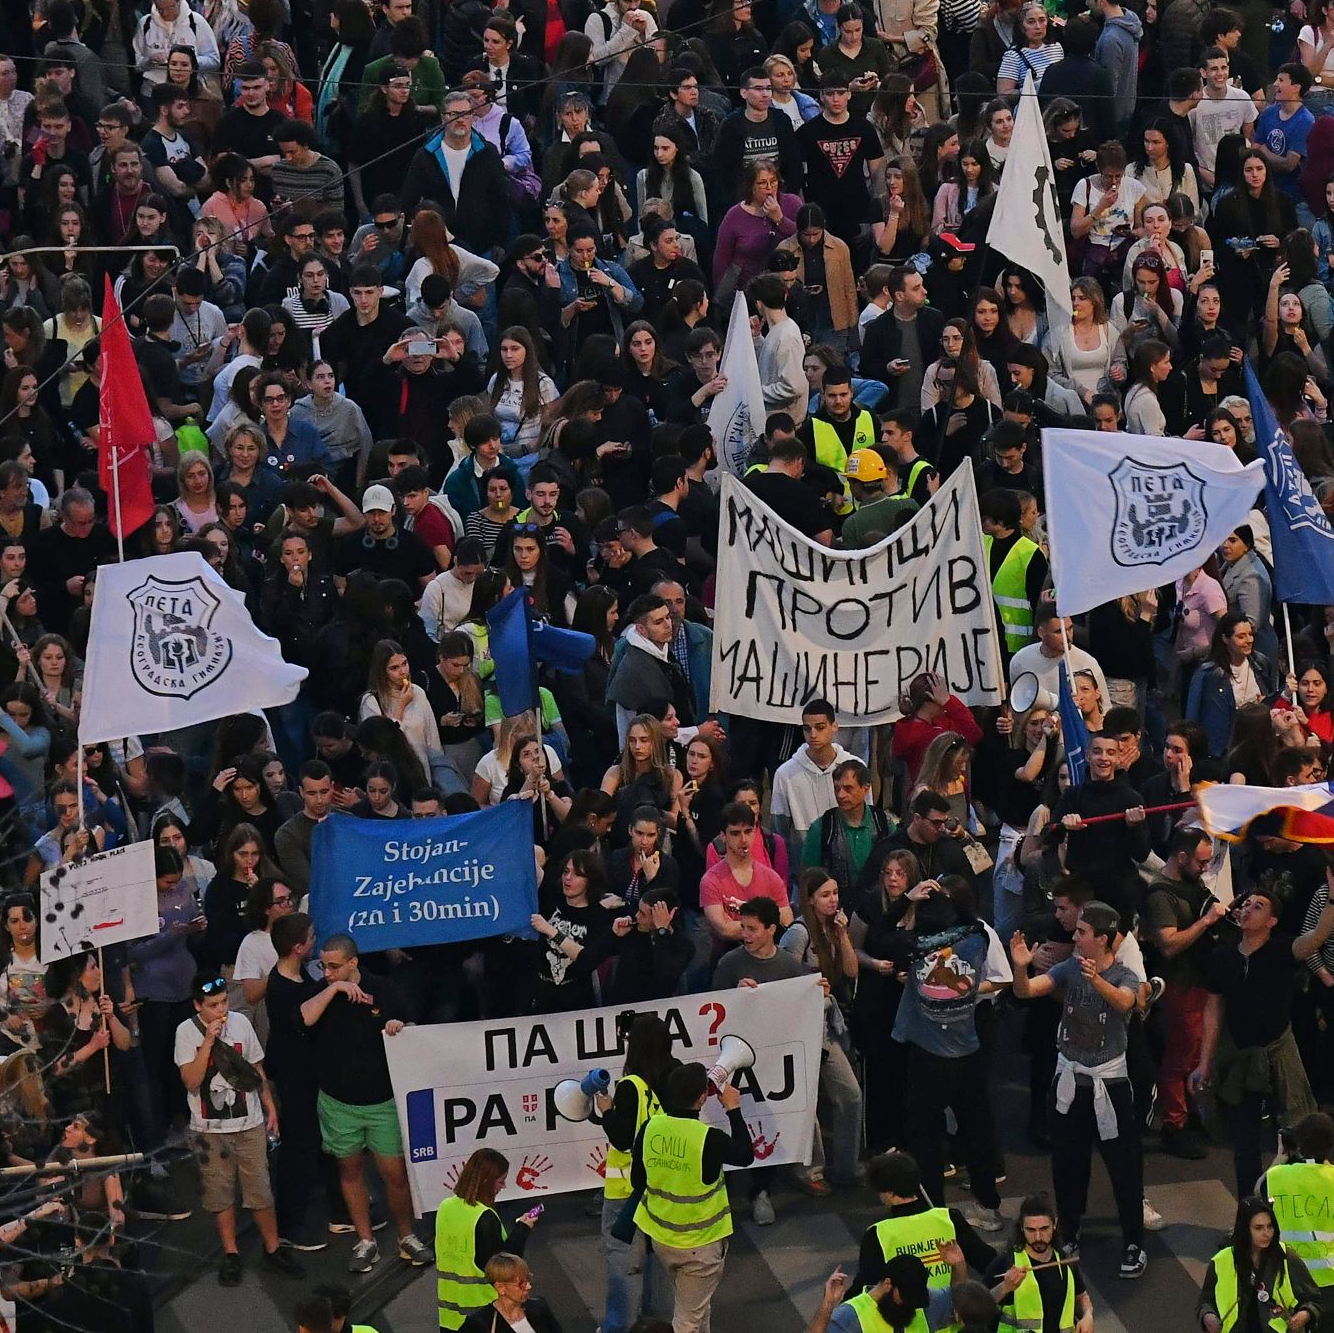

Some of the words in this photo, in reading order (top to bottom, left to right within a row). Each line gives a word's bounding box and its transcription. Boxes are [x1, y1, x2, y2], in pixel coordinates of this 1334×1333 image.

[823, 139, 857, 157] GUESS
[1131, 473, 1185, 493] ПЕТА
[144, 594, 194, 617] ПЕТА
[744, 554, 982, 641] ПРОТИВ
[383, 838, 469, 865] Stojan-
[391, 901, 403, 923] i
[408, 894, 501, 922] 30min)
[484, 1021, 561, 1072] ПА
[575, 1002, 727, 1062] ША?
[444, 1093, 518, 1145] РА
[412, 1145, 435, 1160] SRB
[650, 1134, 688, 1158] СМШ
